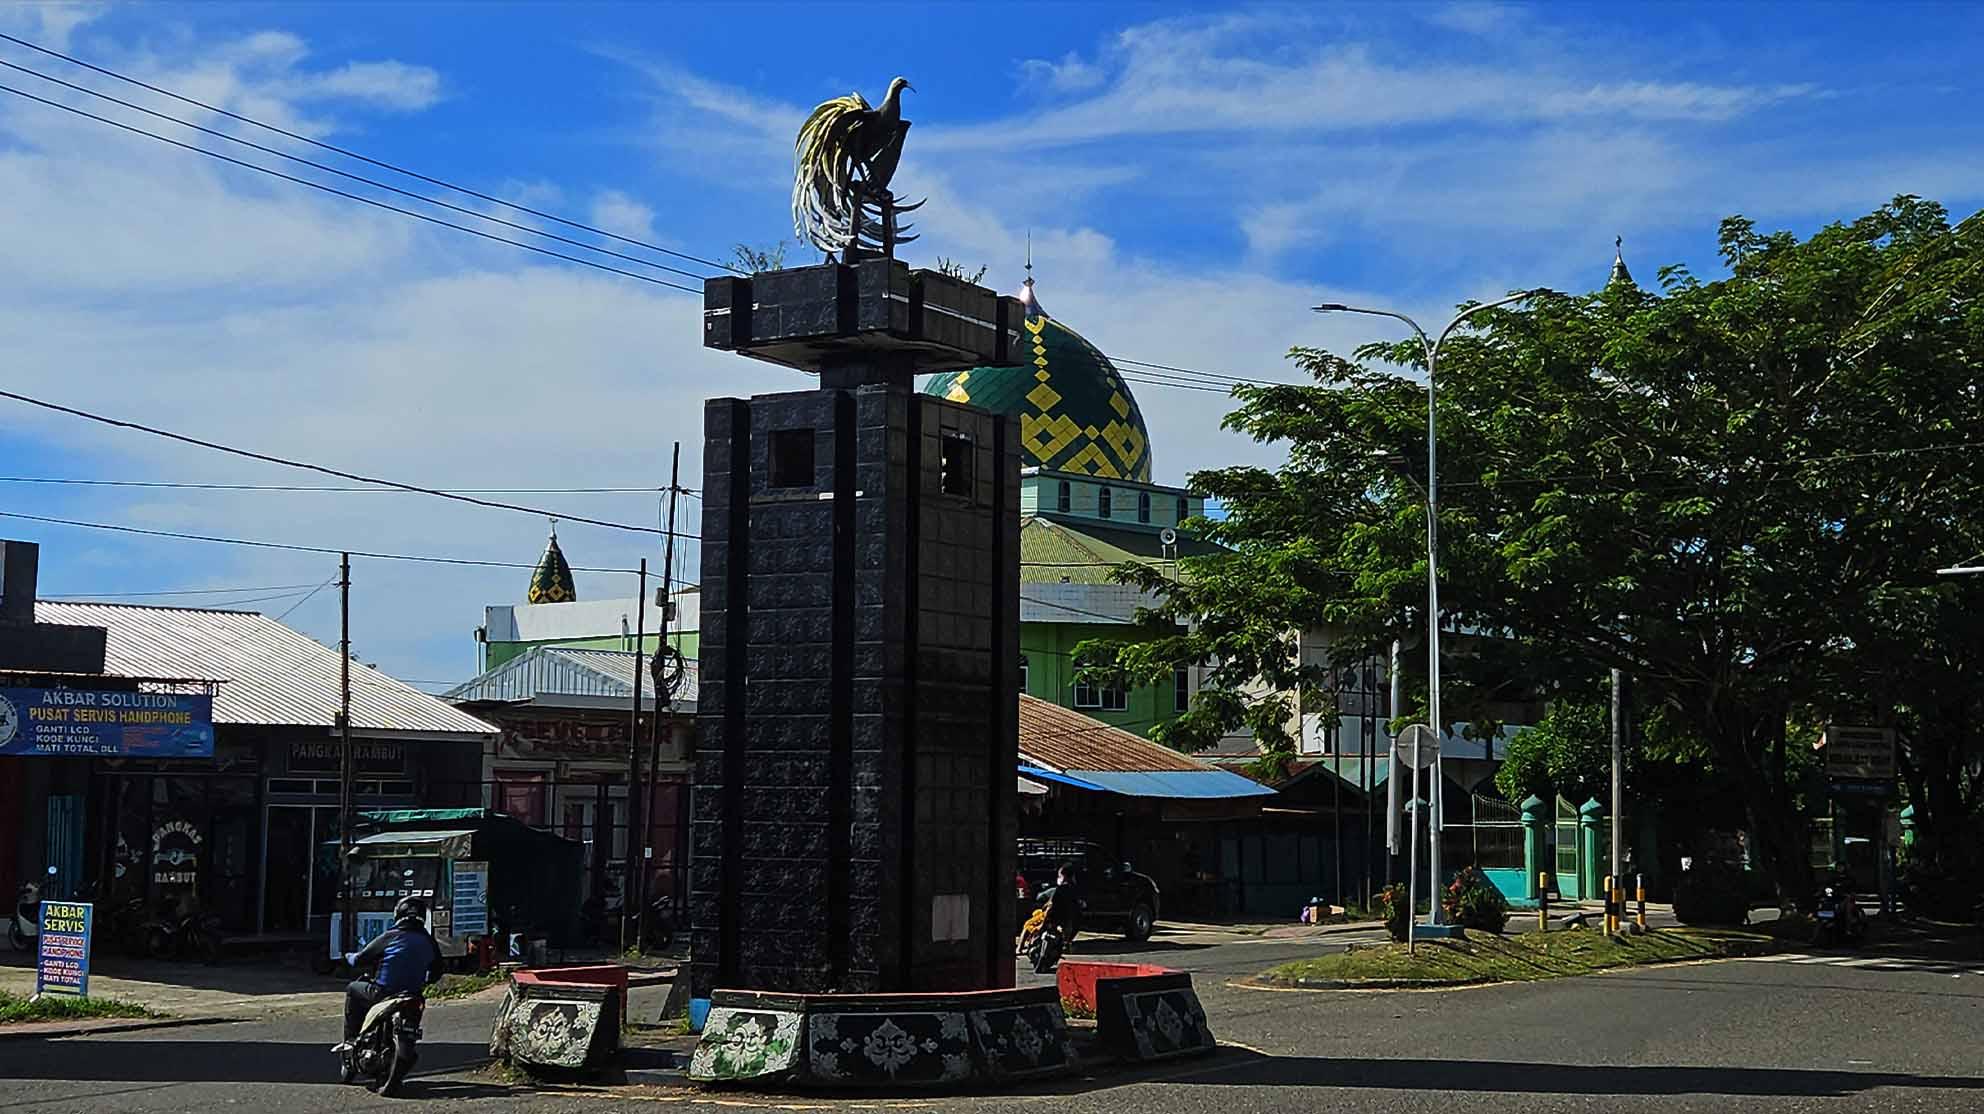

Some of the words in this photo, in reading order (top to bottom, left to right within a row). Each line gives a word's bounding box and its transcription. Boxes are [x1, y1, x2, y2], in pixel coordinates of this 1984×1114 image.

[42, 691, 96, 706] AKBAR
[101, 693, 177, 708] SOLUTION
[29, 707, 69, 721] PUSAT
[73, 708, 116, 722] SERVIS
[119, 711, 191, 724] HANDPHONE
[35, 725, 67, 734] GANTI
[70, 726, 90, 734] LCD
[66, 735, 99, 743] KUNCI
[100, 745, 119, 753] DLL
[290, 744, 342, 760] PANGKA
[353, 744, 401, 760] RAMBUT
[152, 821, 203, 851] PANGKAS
[45, 904, 84, 919] AKBAR
[43, 919, 85, 933] SERVIS
[44, 960, 65, 968] GANTI
[60, 976, 81, 985] TOTAL
